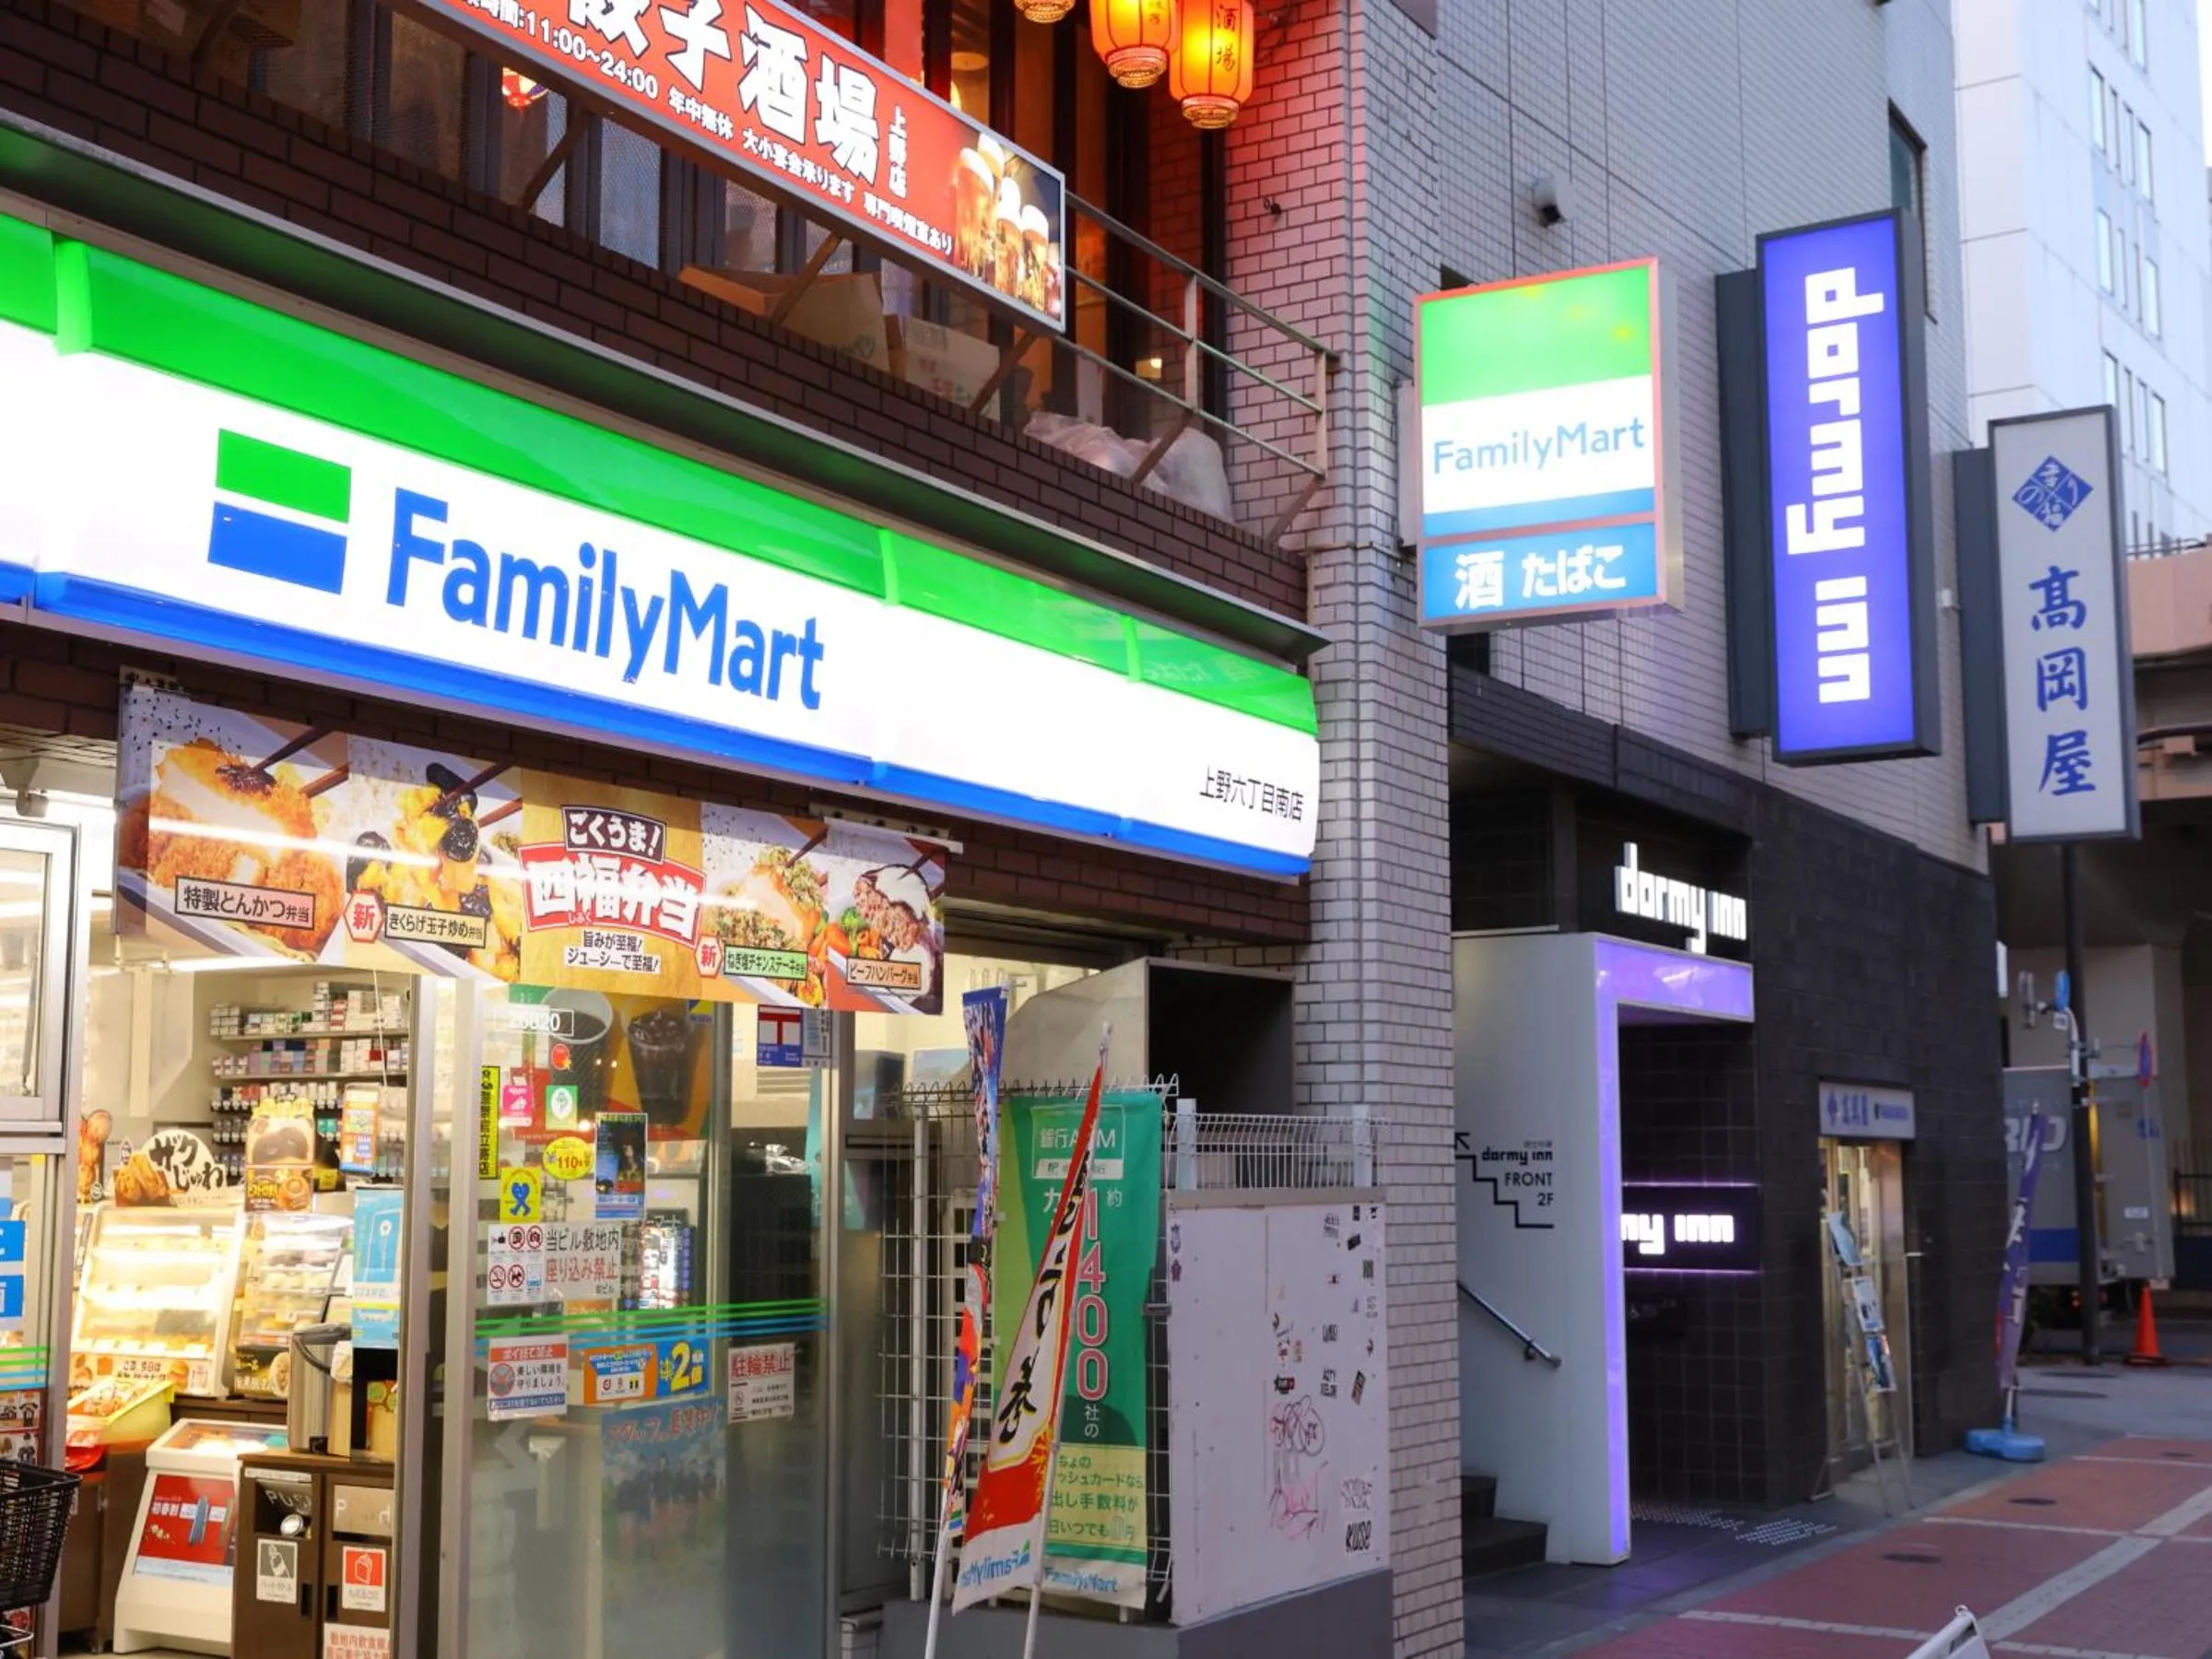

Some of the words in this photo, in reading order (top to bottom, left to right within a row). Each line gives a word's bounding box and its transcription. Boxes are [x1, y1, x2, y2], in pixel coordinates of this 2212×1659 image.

[1786, 266, 1885, 556] dormy
[1432, 418, 1645, 475] FamilyMart
[1453, 551, 1505, 612] 酒
[1521, 545, 1627, 599] たばこ
[386, 487, 825, 711] FamilyMart
[1815, 575, 1870, 705] inn
[569, 810, 661, 857] ごくうま!
[183, 885, 311, 924] 特製とんかつ弁当
[1615, 842, 1707, 955] dormy
[1708, 890, 1747, 941] inn
[353, 901, 377, 932] 新
[388, 912, 484, 940] きくらげ玉子炒め弁当
[700, 944, 717, 968] 新
[1040, 1126, 1116, 1148] 銀行M
[1481, 1147, 1529, 1166] dormy
[1532, 1150, 1553, 1161] inn
[1504, 1171, 1553, 1187] FRONT
[1537, 1193, 1554, 1206] 2F
[546, 1227, 620, 1253] 当ビル敷地内
[1675, 1214, 1735, 1243] inn
[545, 1255, 618, 1283] 座り込み禁止
[1084, 1404, 1100, 1438] 社の
